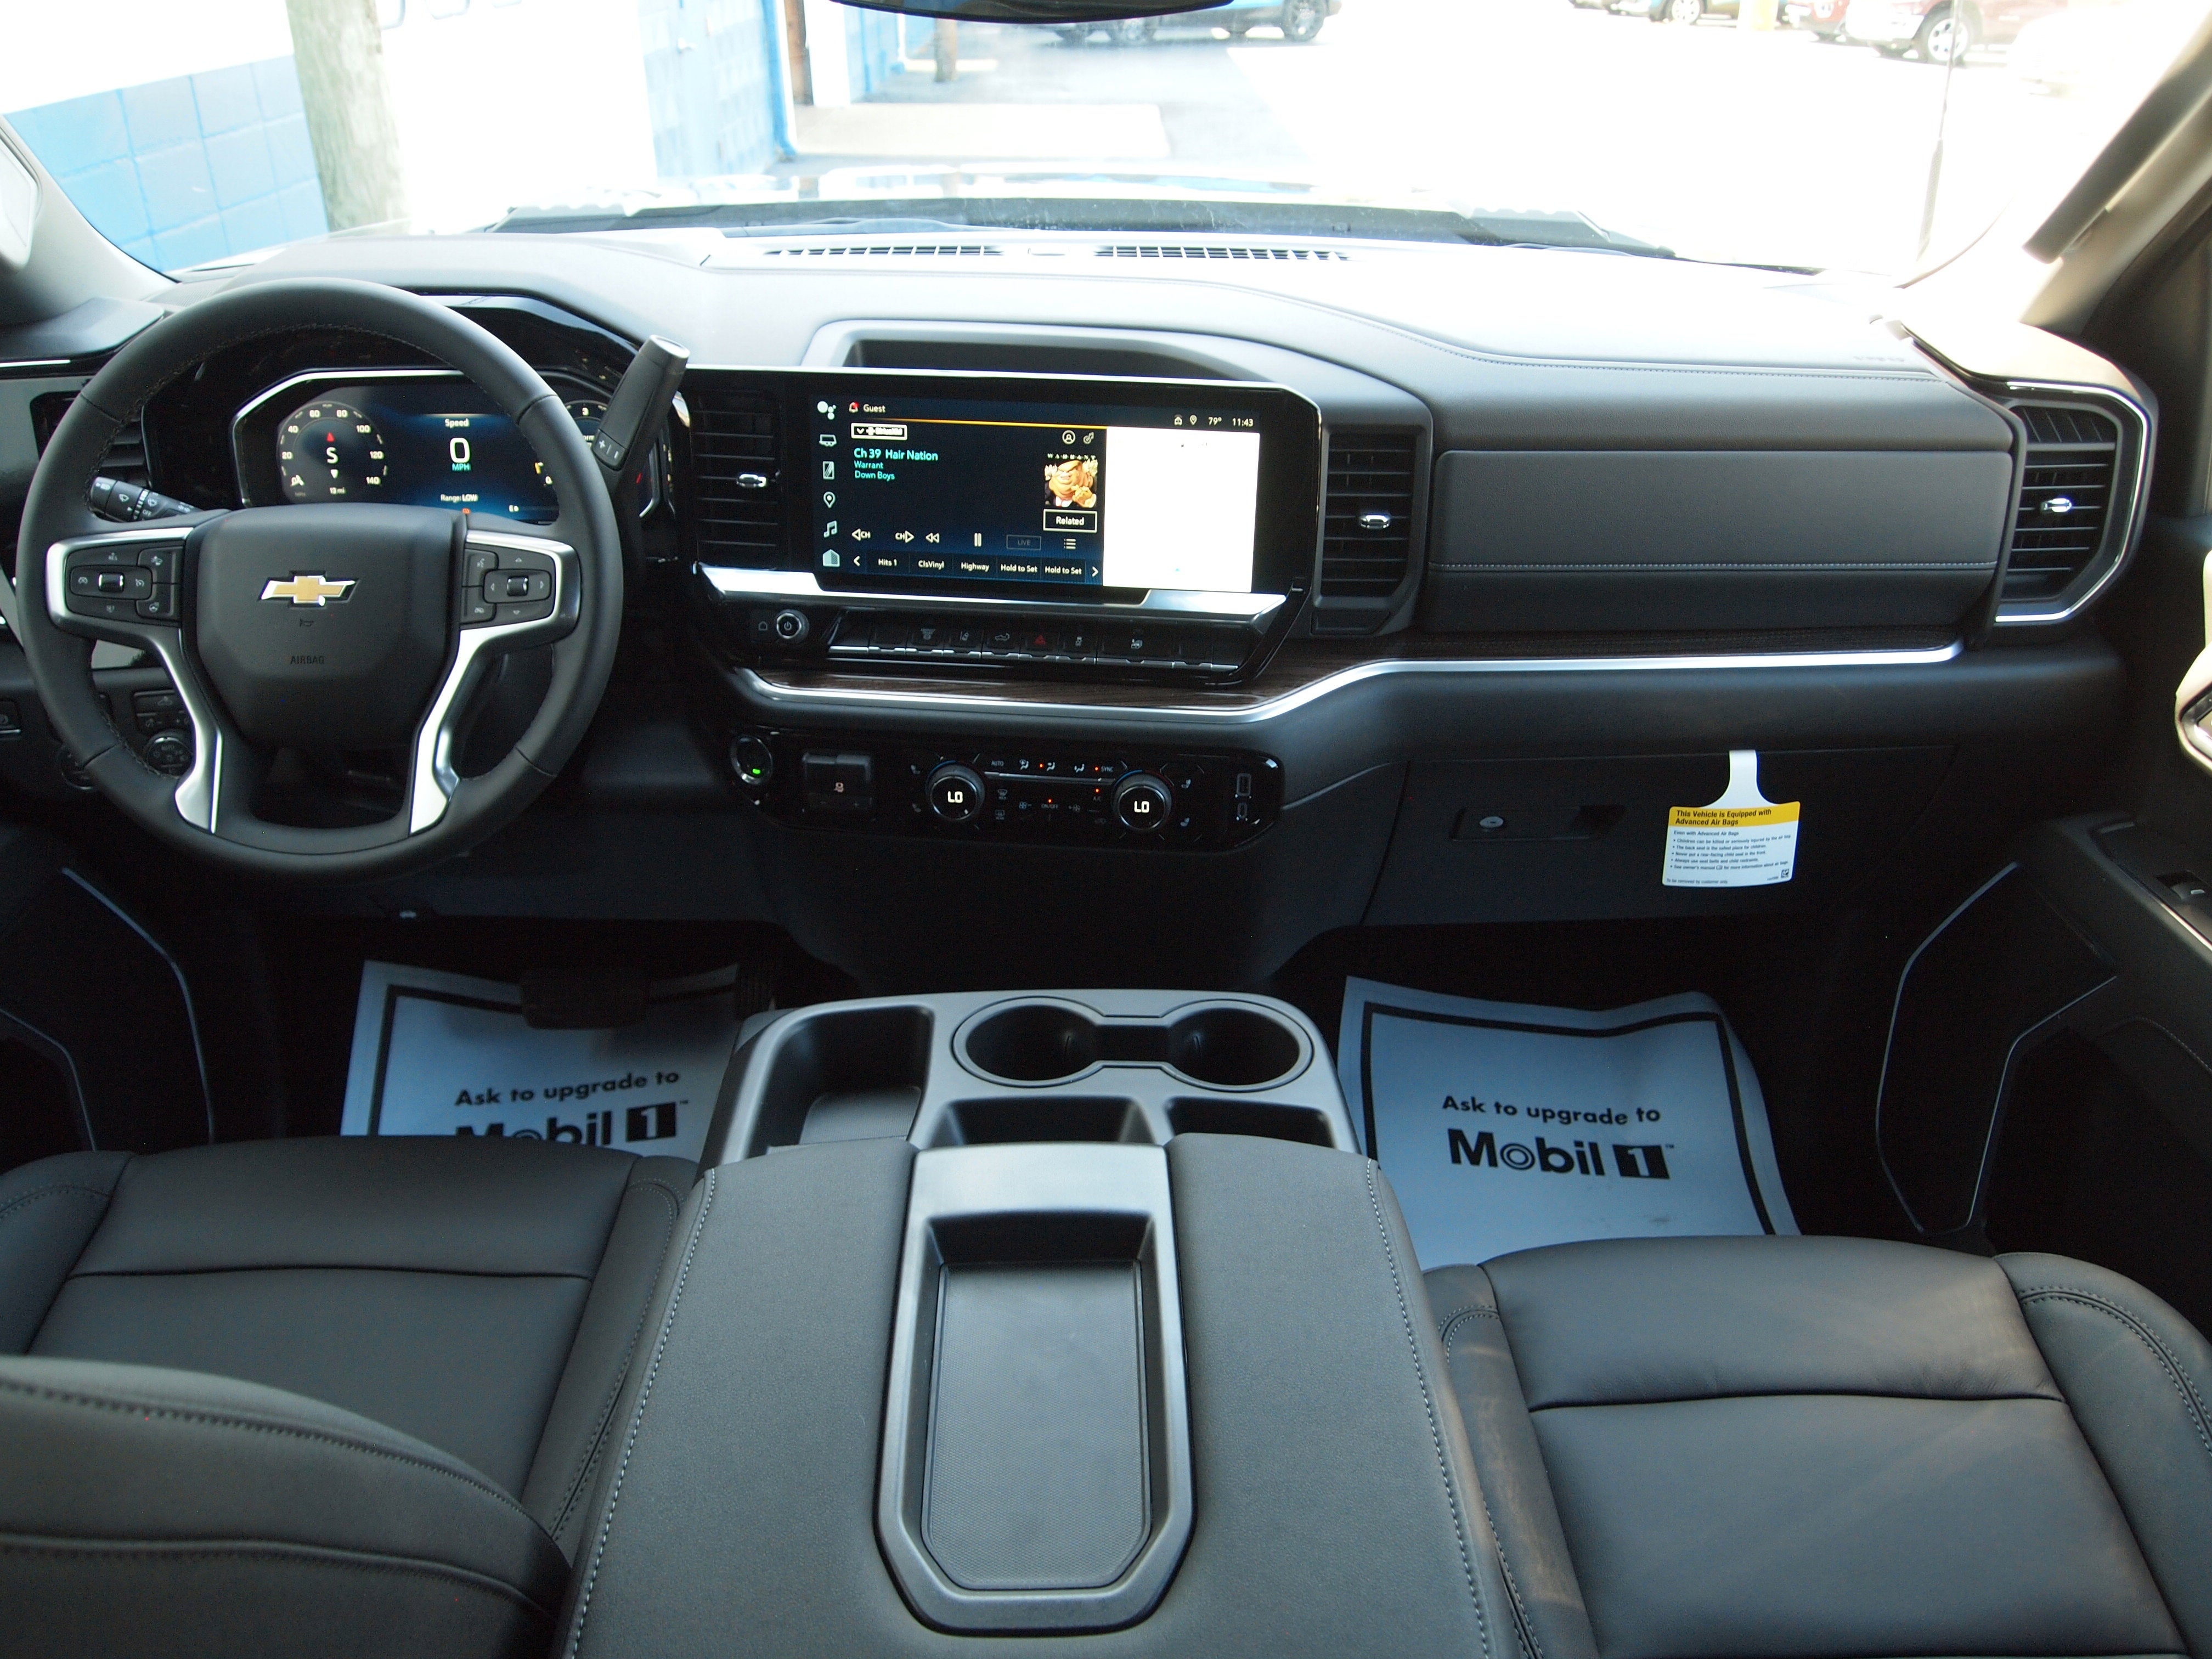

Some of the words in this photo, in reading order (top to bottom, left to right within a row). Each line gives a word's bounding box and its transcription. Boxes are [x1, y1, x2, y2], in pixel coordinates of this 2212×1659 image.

[864, 404, 885, 413] Guest
[445, 418, 470, 428] Speed
[1232, 417, 1254, 427] 11:43
[288, 425, 299, 433] 40
[357, 425, 371, 433] 100
[326, 447, 338, 464] S
[370, 451, 384, 459] 120
[450, 437, 470, 464] 0
[854, 448, 867, 458] Ch
[869, 449, 881, 459] 39
[885, 449, 905, 459] Hair
[907, 450, 938, 461] Nation
[854, 460, 883, 469] Warrant
[366, 476, 381, 485] 140
[855, 470, 876, 479] Down
[878, 471, 895, 482] Boys
[441, 494, 461, 503] Range:
[462, 494, 478, 502] LOW
[1056, 516, 1084, 526] Related
[895, 532, 905, 540] CH
[961, 562, 989, 572] Highway
[290, 656, 325, 664] AIRBAG
[947, 791, 963, 804] LO
[1134, 801, 1149, 813] LO
[454, 1087, 500, 1107] Ask
[511, 1085, 534, 1103] to
[544, 1072, 647, 1101] upgrade
[655, 1070, 679, 1084] to
[1442, 1096, 1486, 1114] Ask
[1494, 1101, 1517, 1115] to
[1527, 1106, 1628, 1125] upgrade
[1637, 1107, 1661, 1122] to
[1447, 1128, 1605, 1176] Mobil
